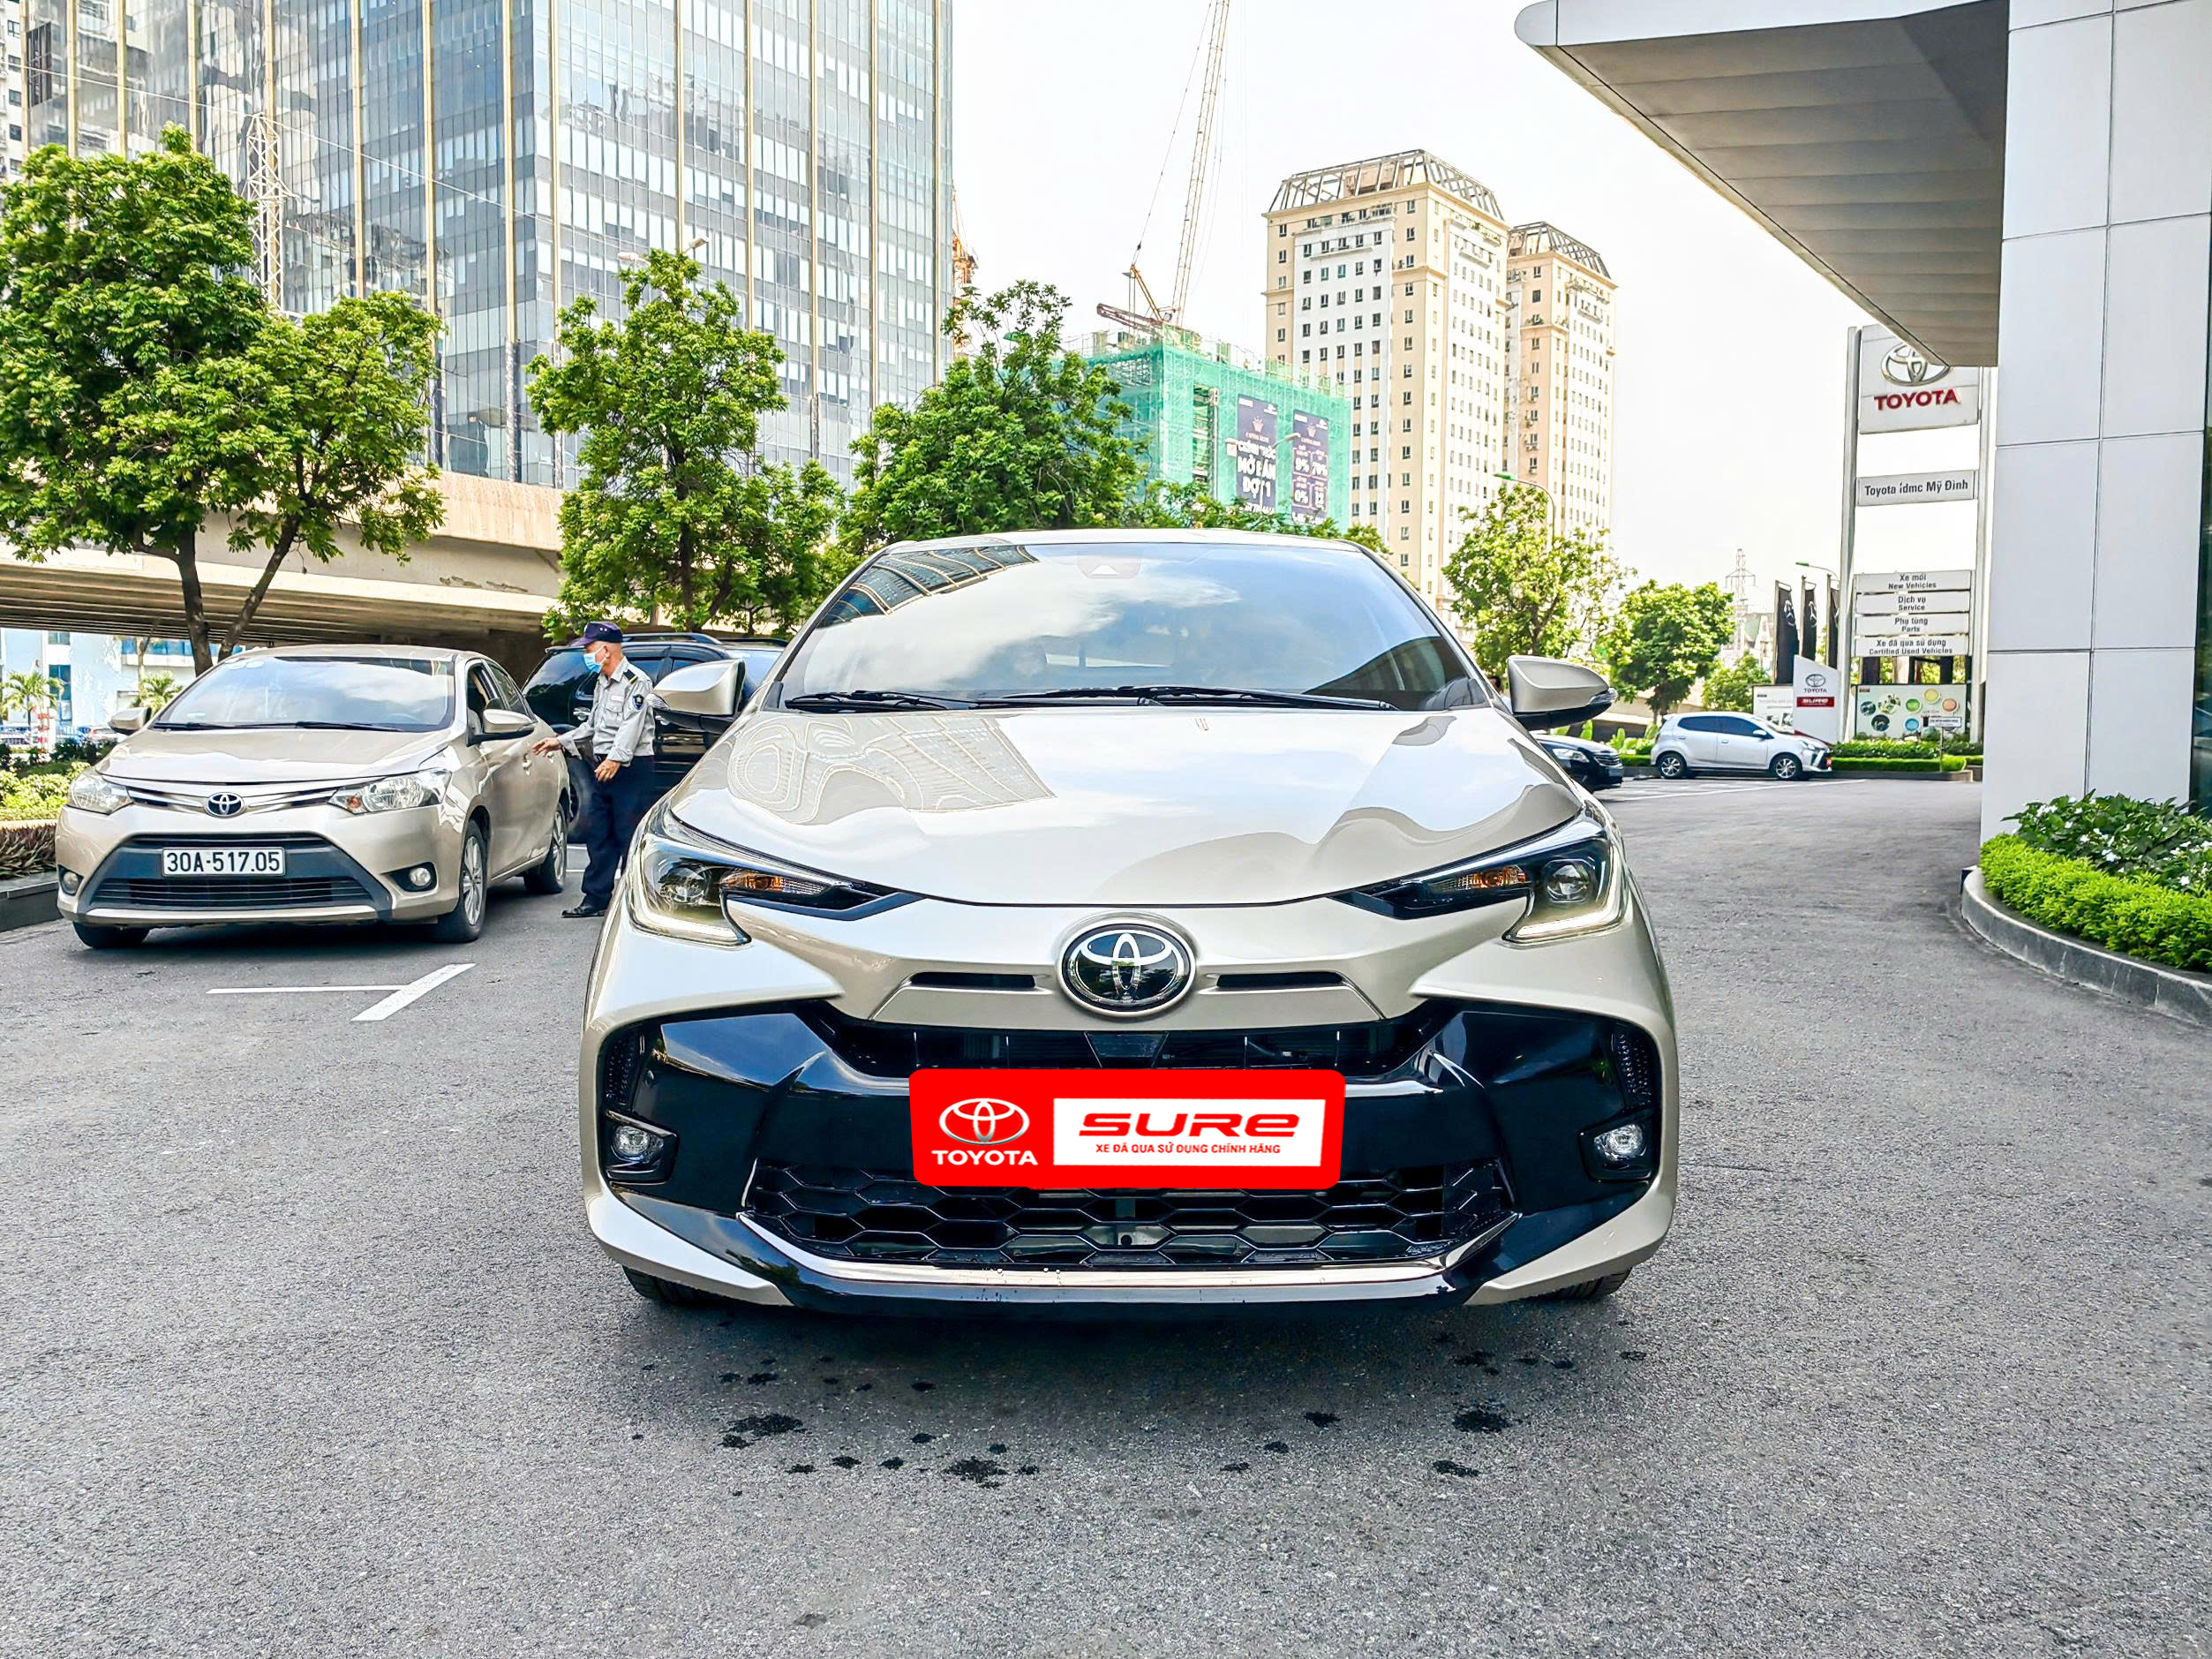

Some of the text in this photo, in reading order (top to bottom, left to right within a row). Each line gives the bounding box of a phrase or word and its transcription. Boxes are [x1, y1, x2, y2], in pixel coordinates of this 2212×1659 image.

[1873, 388, 1961, 411] TOYOTA
[1864, 485, 1896, 498] Toyota
[1926, 480, 1942, 494] Mỹ
[1945, 479, 1968, 491] Đình
[1927, 638, 1946, 647] dụng
[167, 851, 280, 872] 30A-517.05
